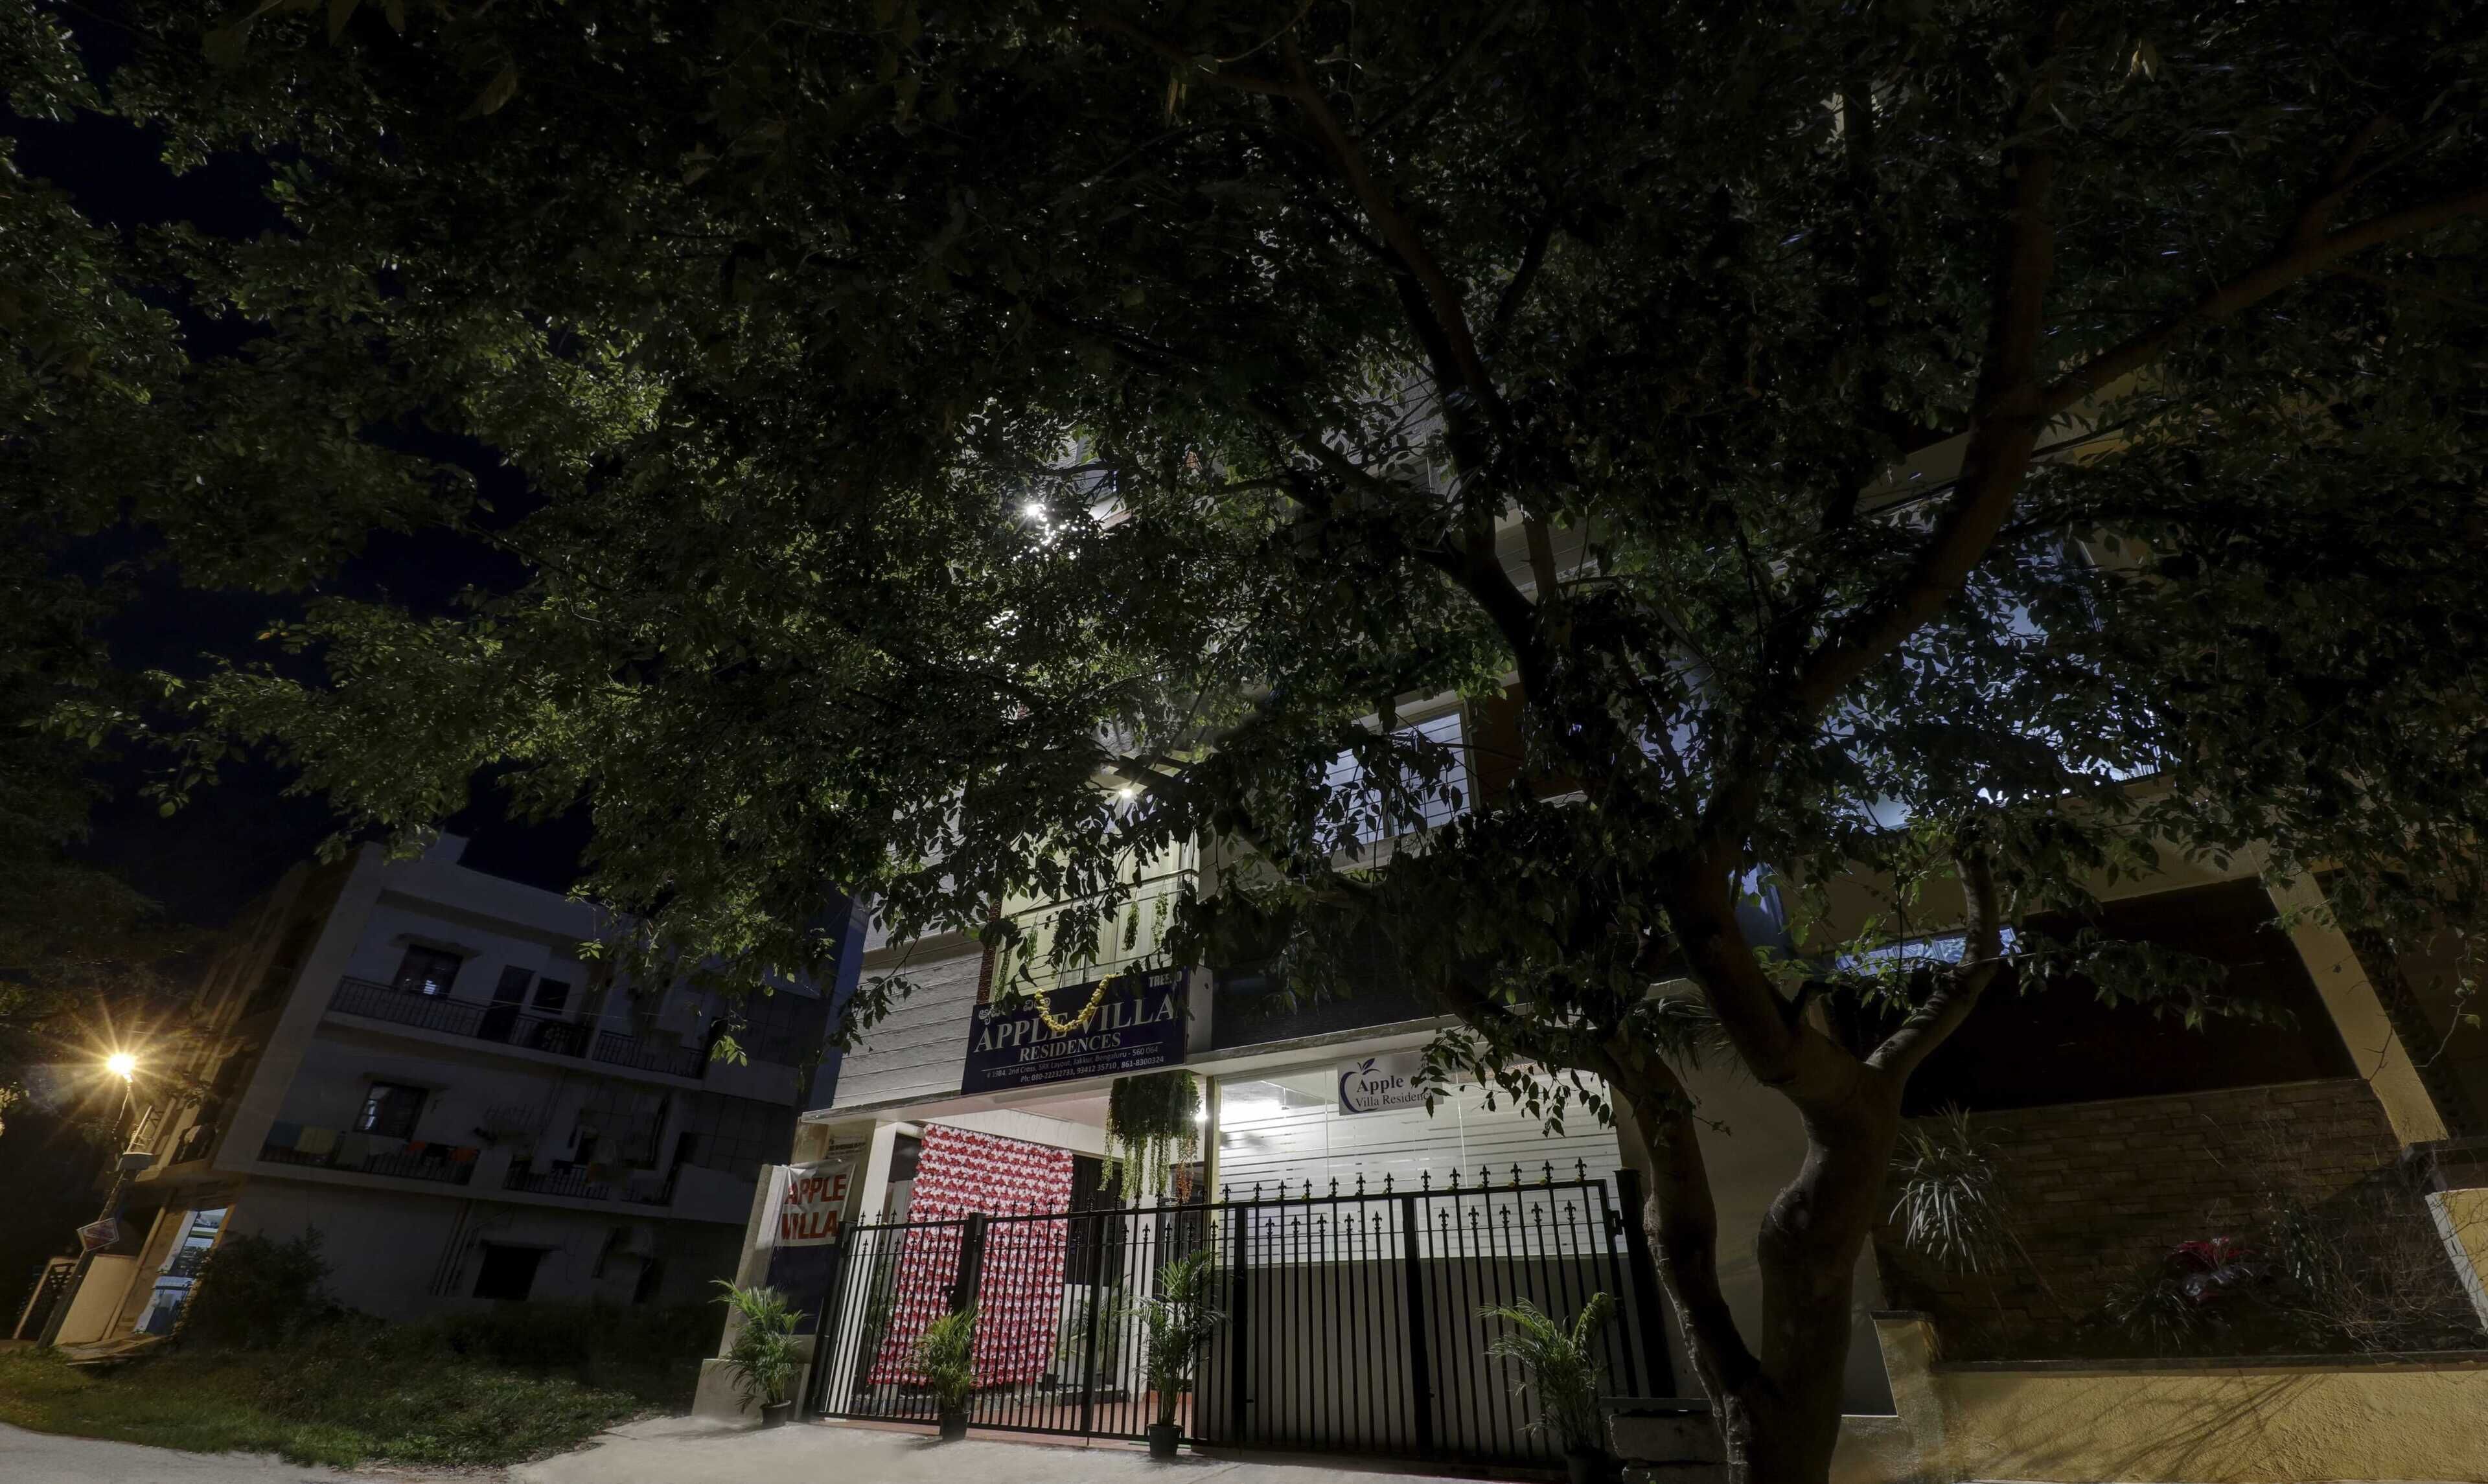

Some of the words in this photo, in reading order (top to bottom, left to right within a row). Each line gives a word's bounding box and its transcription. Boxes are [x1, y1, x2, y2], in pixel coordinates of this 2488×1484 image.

[1149, 970, 1182, 988] TREEO
[974, 1012, 1068, 1053] APPLE
[1078, 994, 1177, 1035] VILLA
[1019, 1031, 1122, 1063] RESIDENCES
[1132, 1048, 1144, 1056] 560
[1357, 1075, 1405, 1095] Apple
[1356, 1097, 1379, 1108] Villa
[784, 1174, 846, 1205] APPLE
[782, 1211, 840, 1240] VILLA
